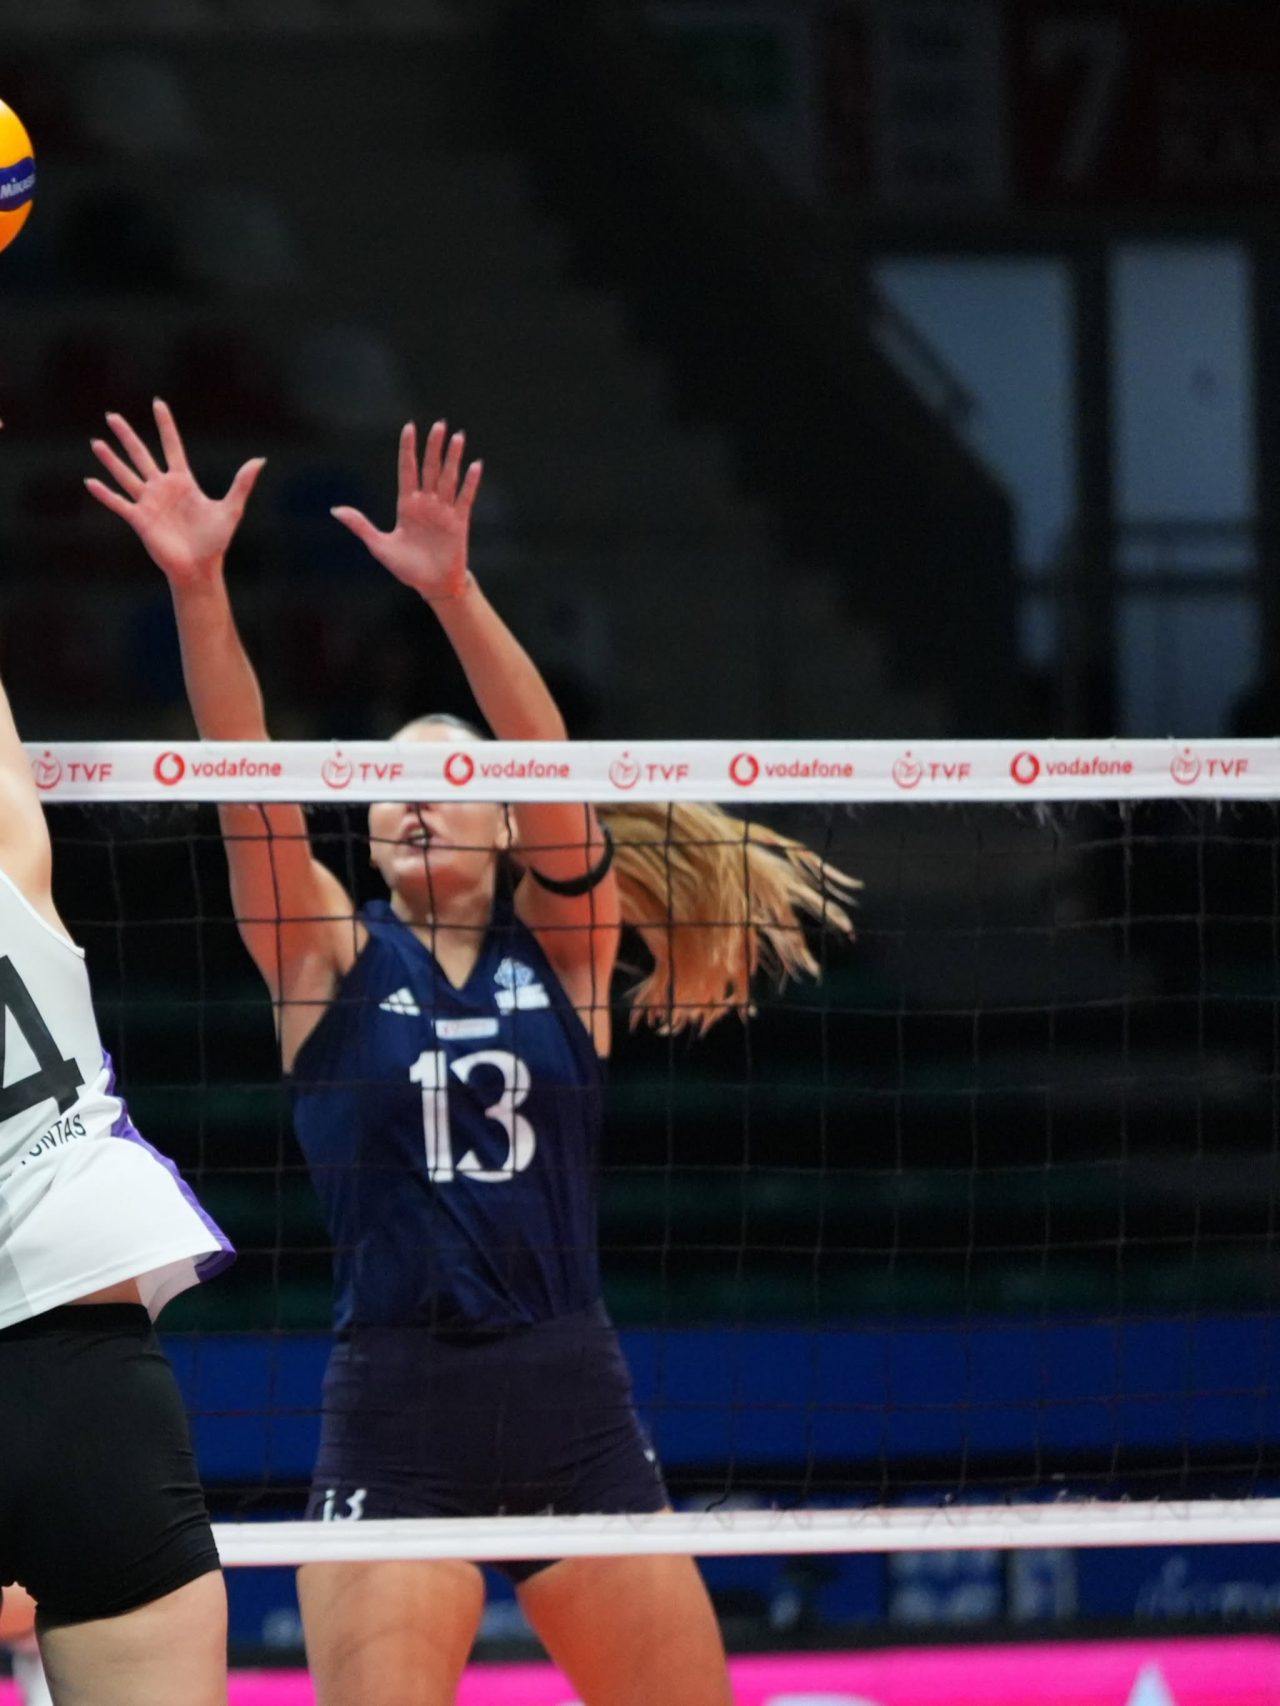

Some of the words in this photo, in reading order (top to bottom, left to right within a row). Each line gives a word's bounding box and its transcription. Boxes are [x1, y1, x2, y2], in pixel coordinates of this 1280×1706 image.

[67, 763, 112, 782] TVF
[191, 759, 282, 778] vodafone
[359, 763, 403, 781] TVF
[480, 759, 569, 779] vodafone
[645, 764, 689, 781] TVF
[764, 760, 853, 779] vodafone
[929, 763, 972, 780] TVF
[1046, 757, 1133, 777] vodafone
[1206, 759, 1248, 778] TVF
[409, 1050, 536, 1183] 13
